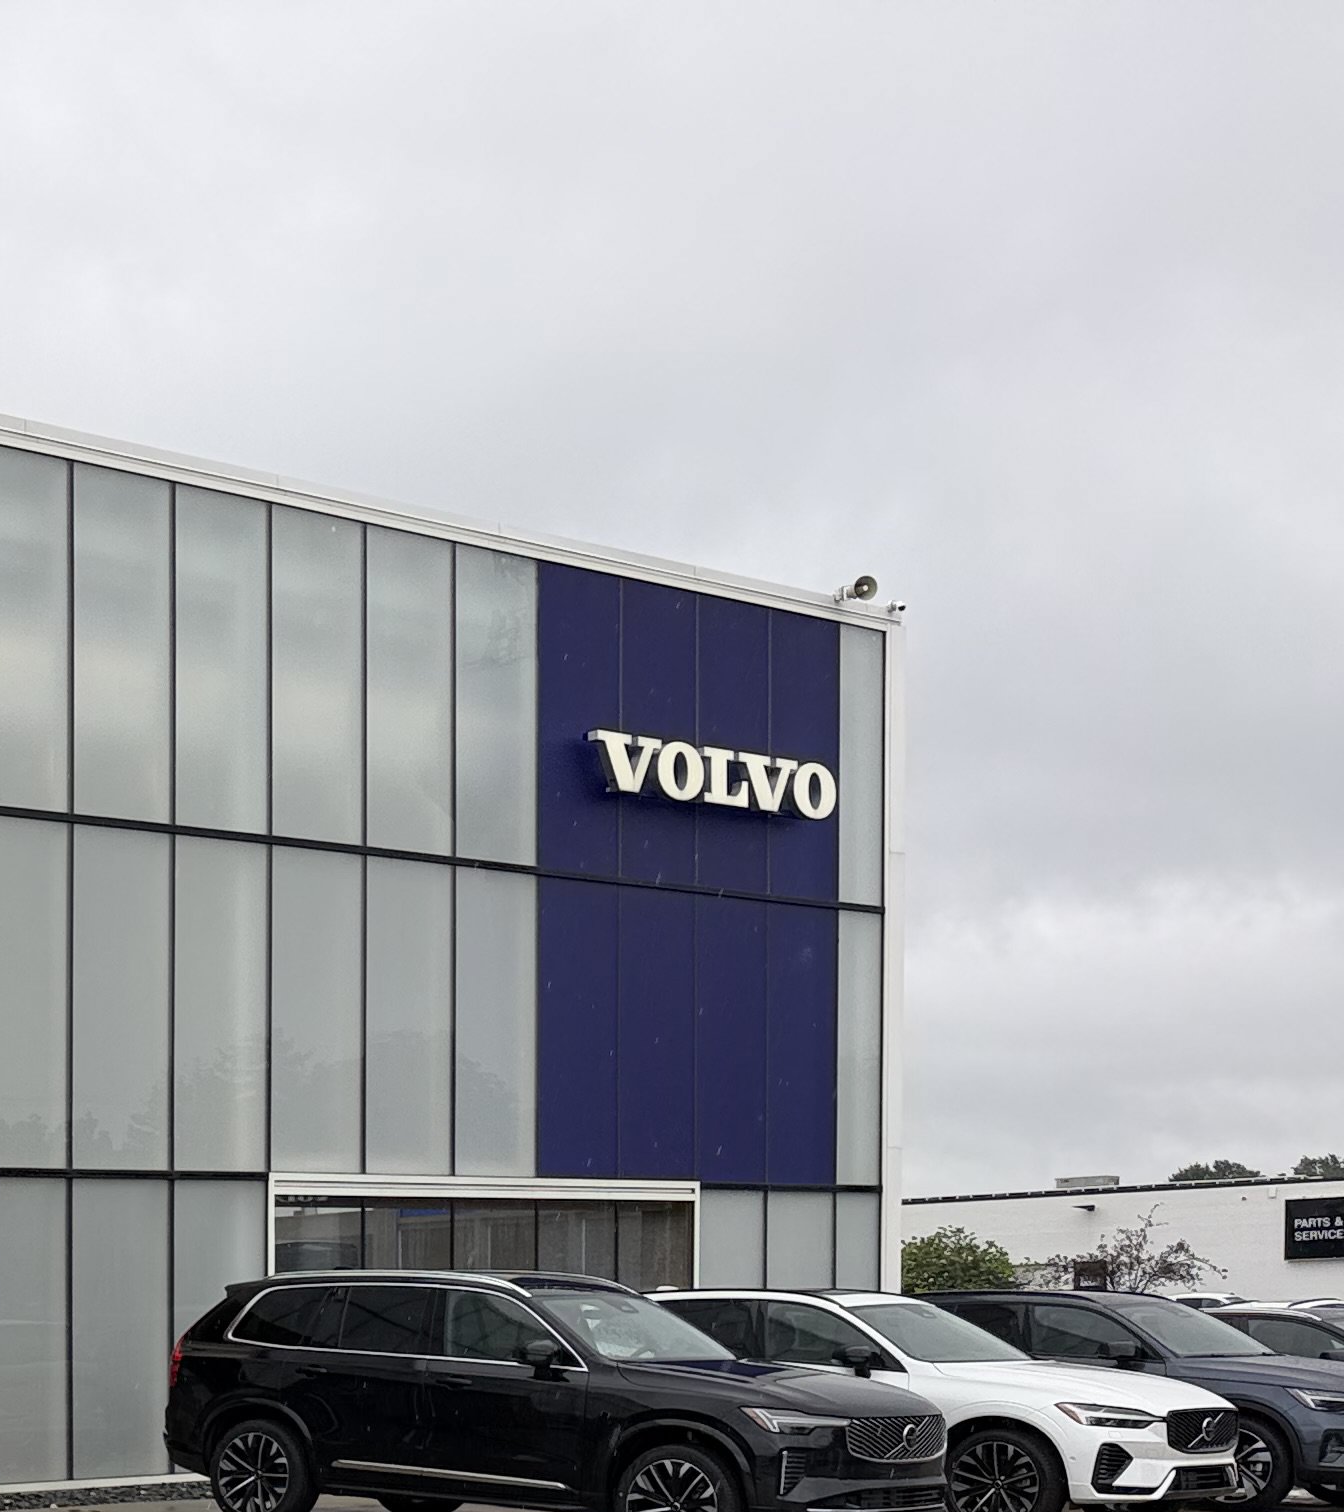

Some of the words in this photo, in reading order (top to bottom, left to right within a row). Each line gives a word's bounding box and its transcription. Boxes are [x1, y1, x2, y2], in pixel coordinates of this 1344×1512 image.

[586, 729, 837, 820] VOLVO
[1294, 1217, 1331, 1229] PARTS
[1335, 1216, 1344, 1227] &
[1294, 1229, 1344, 1241] SERVICE
